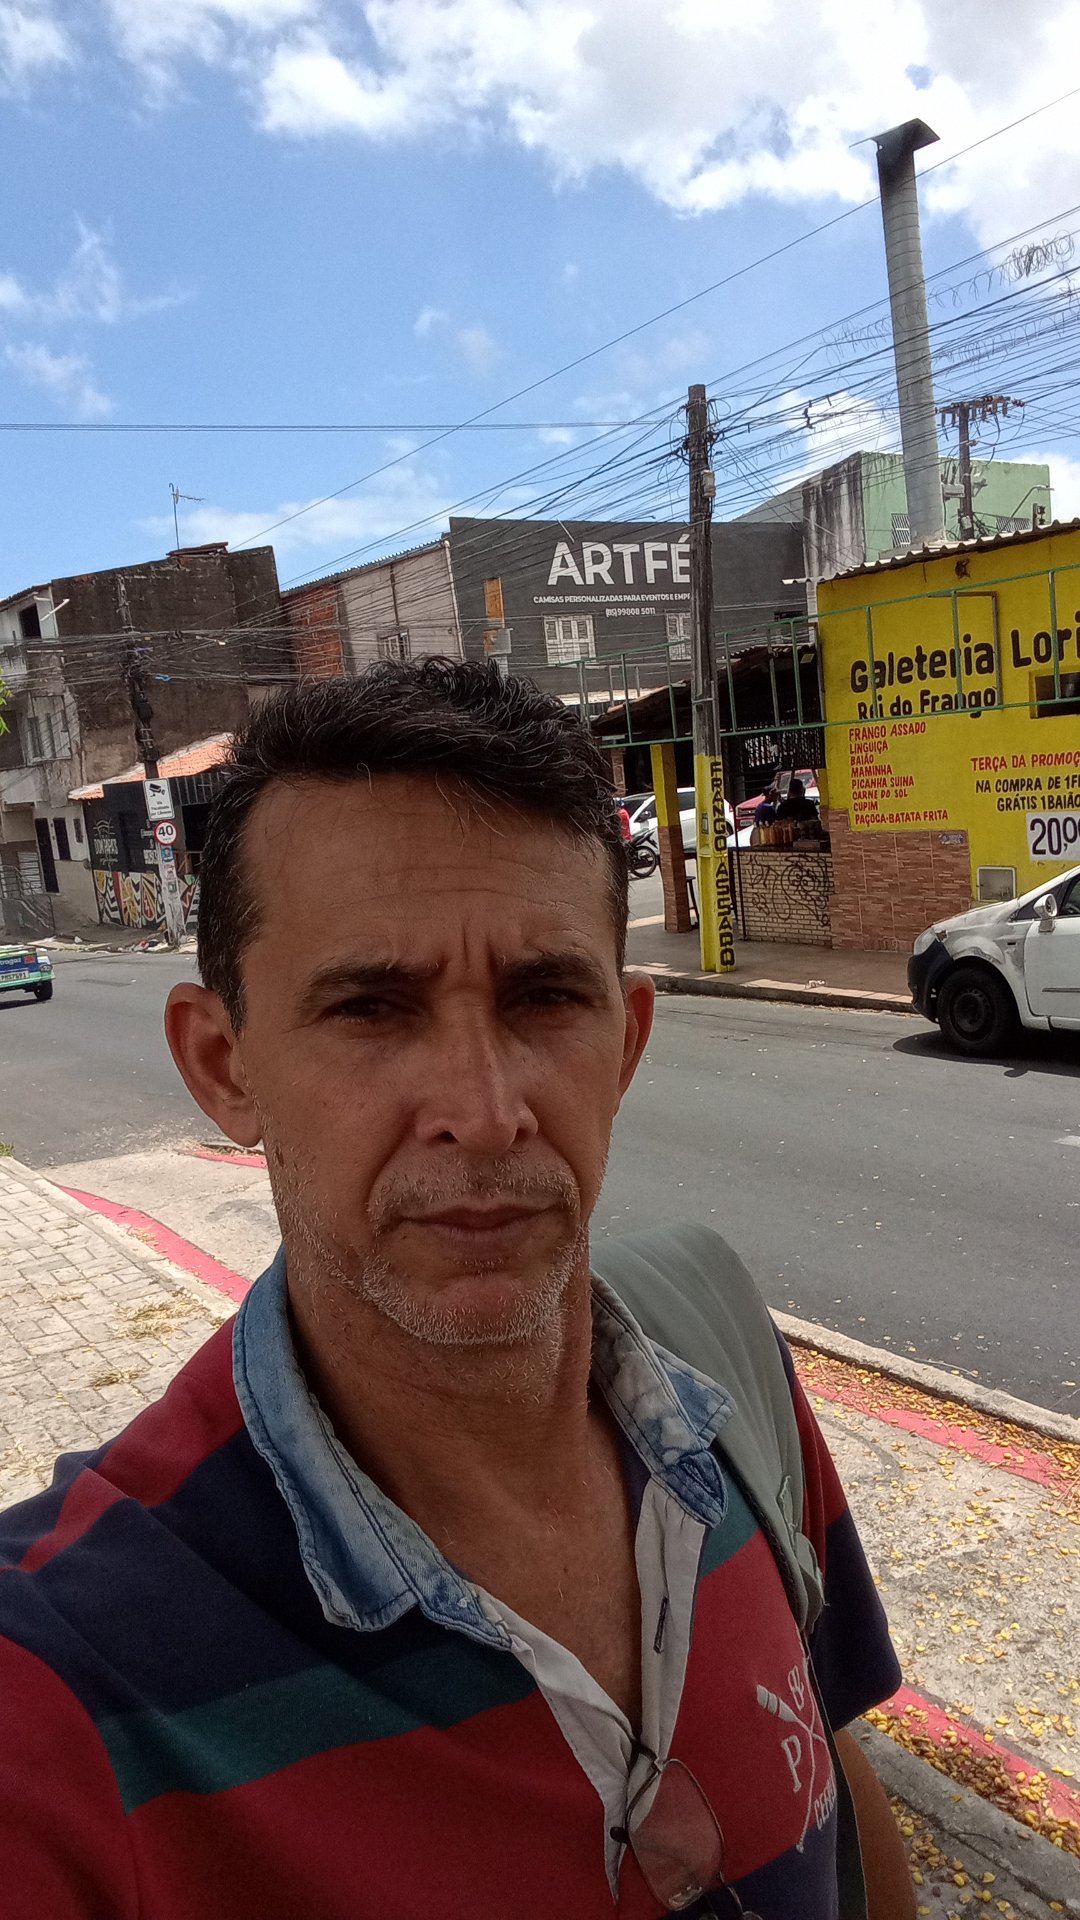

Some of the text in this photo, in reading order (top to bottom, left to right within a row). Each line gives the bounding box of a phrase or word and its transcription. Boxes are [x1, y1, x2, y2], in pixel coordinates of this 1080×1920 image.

[547, 533, 690, 586] ARTFÉ
[533, 595, 564, 604] CAMISAS
[564, 594, 622, 603] PERSONALIZADAS
[623, 594, 641, 602] PARA
[641, 593, 669, 602] EVENTOS
[850, 633, 994, 693] Galeteria
[889, 695, 912, 717] do
[919, 688, 996, 719] Frango
[849, 721, 926, 741] FRANGO ASSADO
[849, 740, 888, 754] LINGUIÇA
[850, 753, 874, 766] BAIÃO
[970, 755, 1007, 772] TERÇA
[1011, 754, 1026, 768] DA
[851, 764, 892, 778] MAMINHA
[852, 777, 887, 789] PICANHA
[975, 780, 991, 793] NA
[995, 777, 1042, 793] COMPRA
[1047, 776, 1061, 790] DE
[852, 788, 908, 800] CARNE DO SOL
[997, 793, 1037, 811] GRÁTIS
[710, 761, 727, 852] FRANGO
[853, 801, 878, 812] CUPIM
[923, 809, 948, 821] FRITA
[158, 825, 174, 837] 40
[715, 861, 736, 967] ASSADO
[780, 1734, 802, 1792] P
